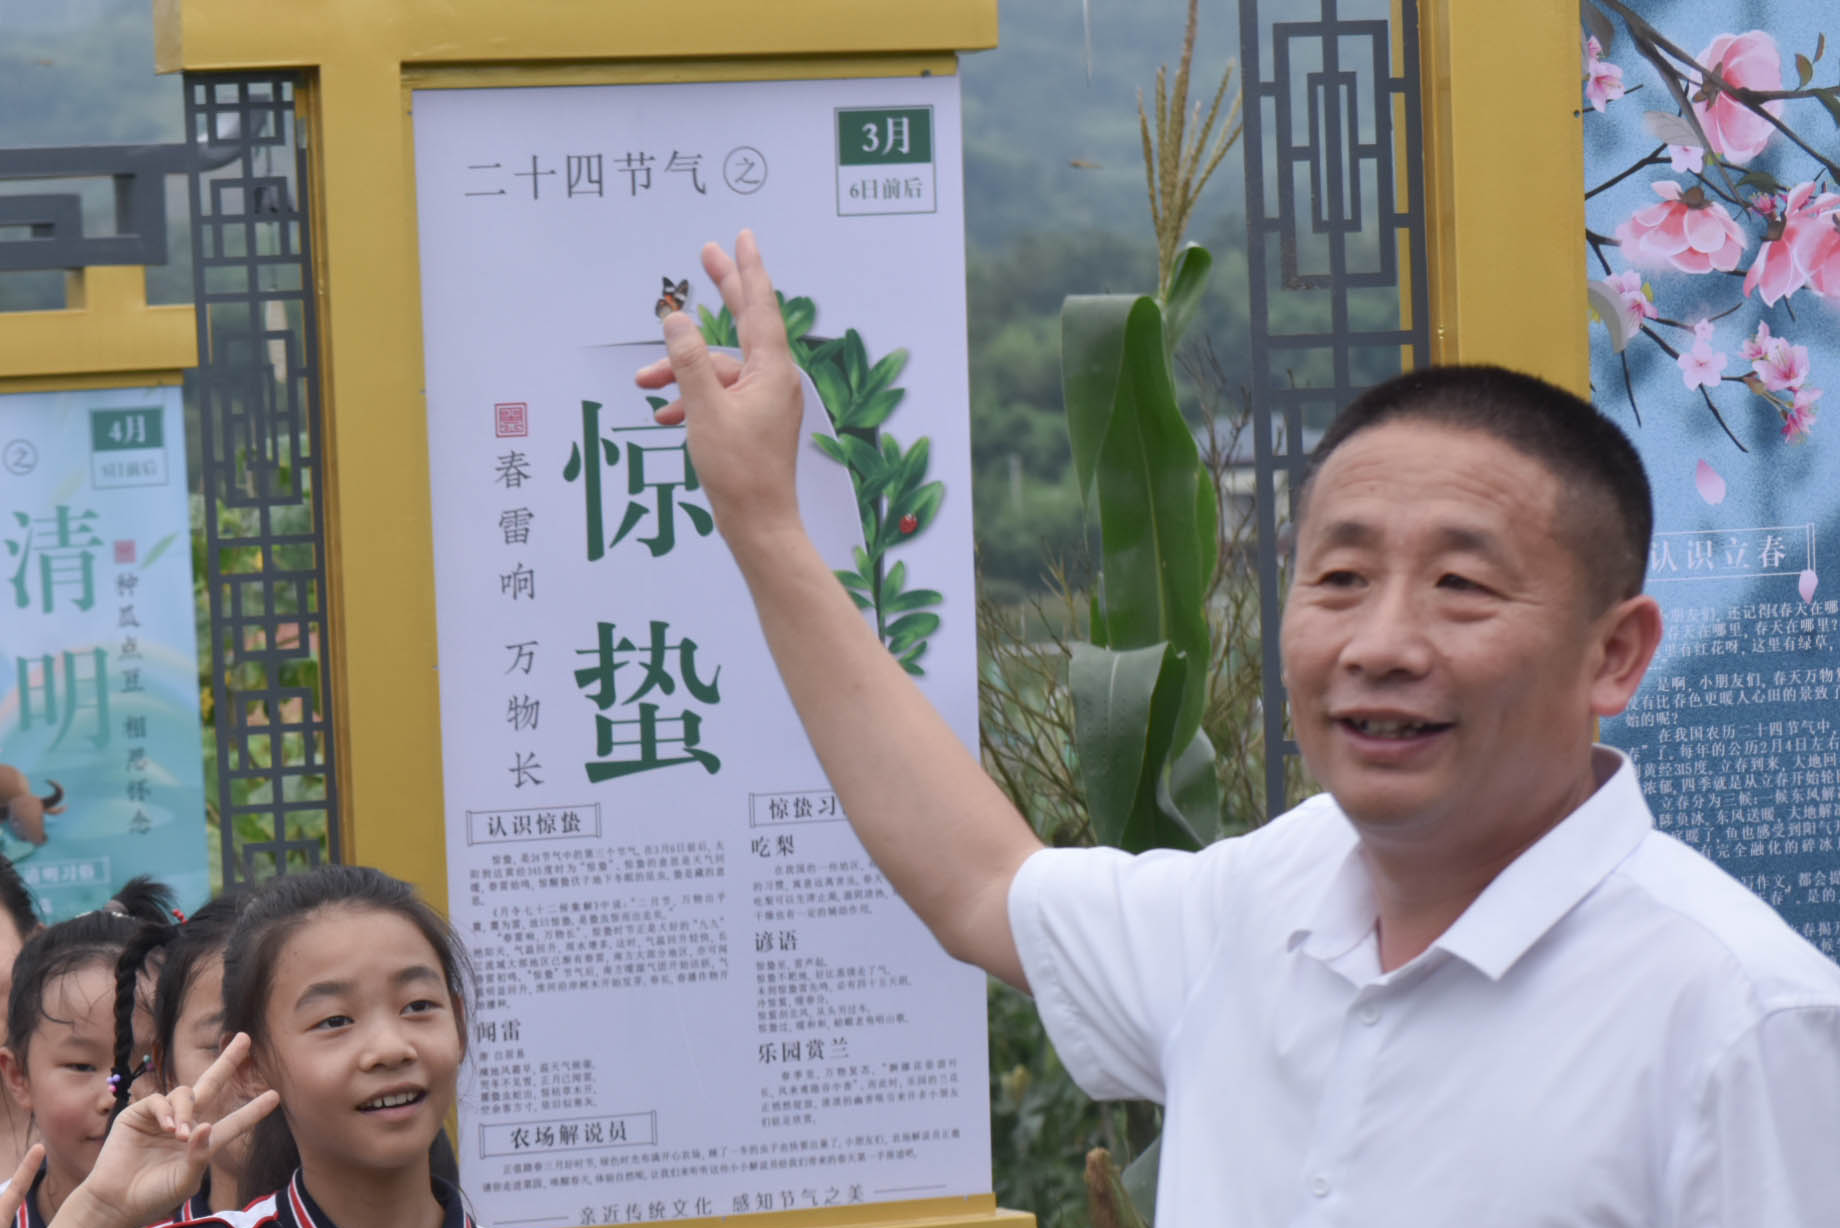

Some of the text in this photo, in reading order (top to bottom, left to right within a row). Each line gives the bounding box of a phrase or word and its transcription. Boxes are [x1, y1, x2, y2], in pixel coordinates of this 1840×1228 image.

[862, 117, 911, 155] 3月
[849, 177, 922, 200] 6日前后
[1650, 535, 1785, 573] 认识立春
[4, 504, 112, 752] 清明
[487, 811, 582, 838] 认识惊蛰
[751, 834, 795, 858] 吃梨
[755, 930, 798, 953] 谚语
[476, 1019, 522, 1044] 闻雷
[757, 1036, 850, 1064] 乐园赏兰
[509, 1120, 628, 1150] 农场解说员
[579, 1184, 865, 1227] 亲近传统文化 感知节气之美
